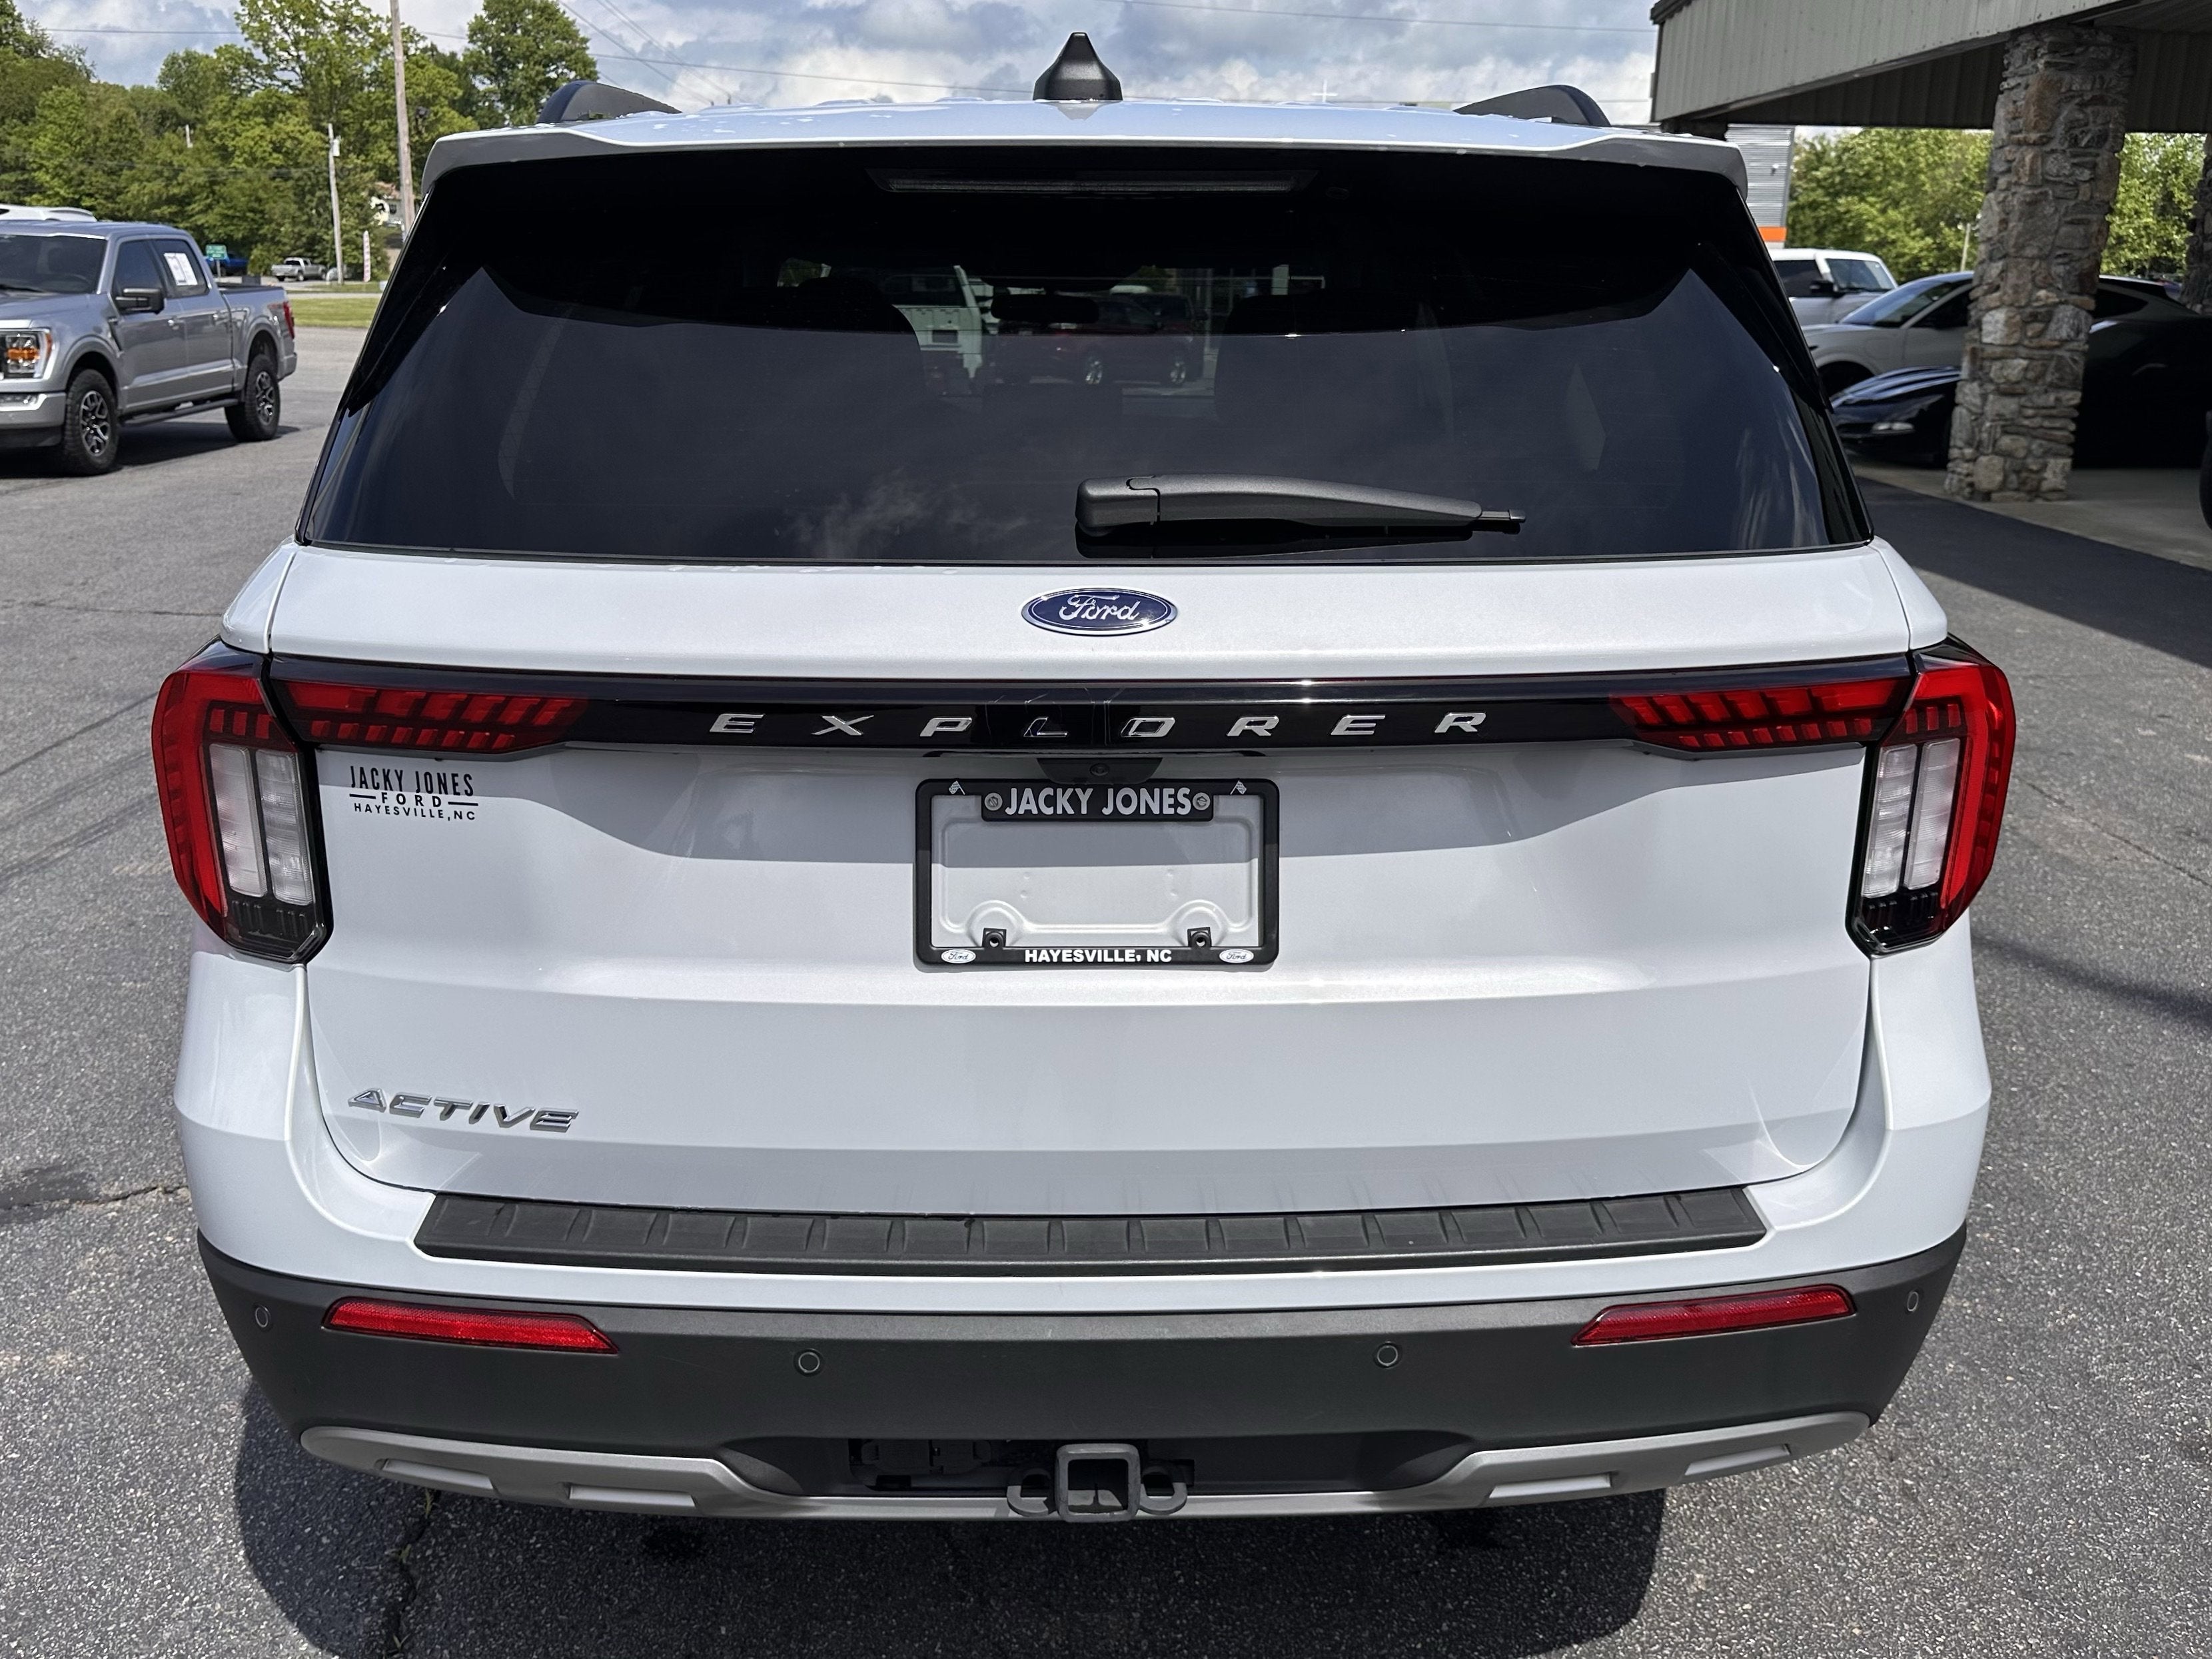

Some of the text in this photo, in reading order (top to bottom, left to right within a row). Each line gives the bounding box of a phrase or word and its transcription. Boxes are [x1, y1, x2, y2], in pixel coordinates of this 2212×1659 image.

[1059, 594, 1141, 620] Ford
[708, 712, 1487, 738] EXPLORER
[350, 766, 474, 796] JACKY JONES
[382, 792, 442, 808] FORD
[1005, 787, 1191, 816] JACKY JONES
[1025, 948, 1172, 963] HAYESVILLE, NC
[1226, 951, 1247, 960] Ford
[347, 1087, 580, 1133] ACTIVE
